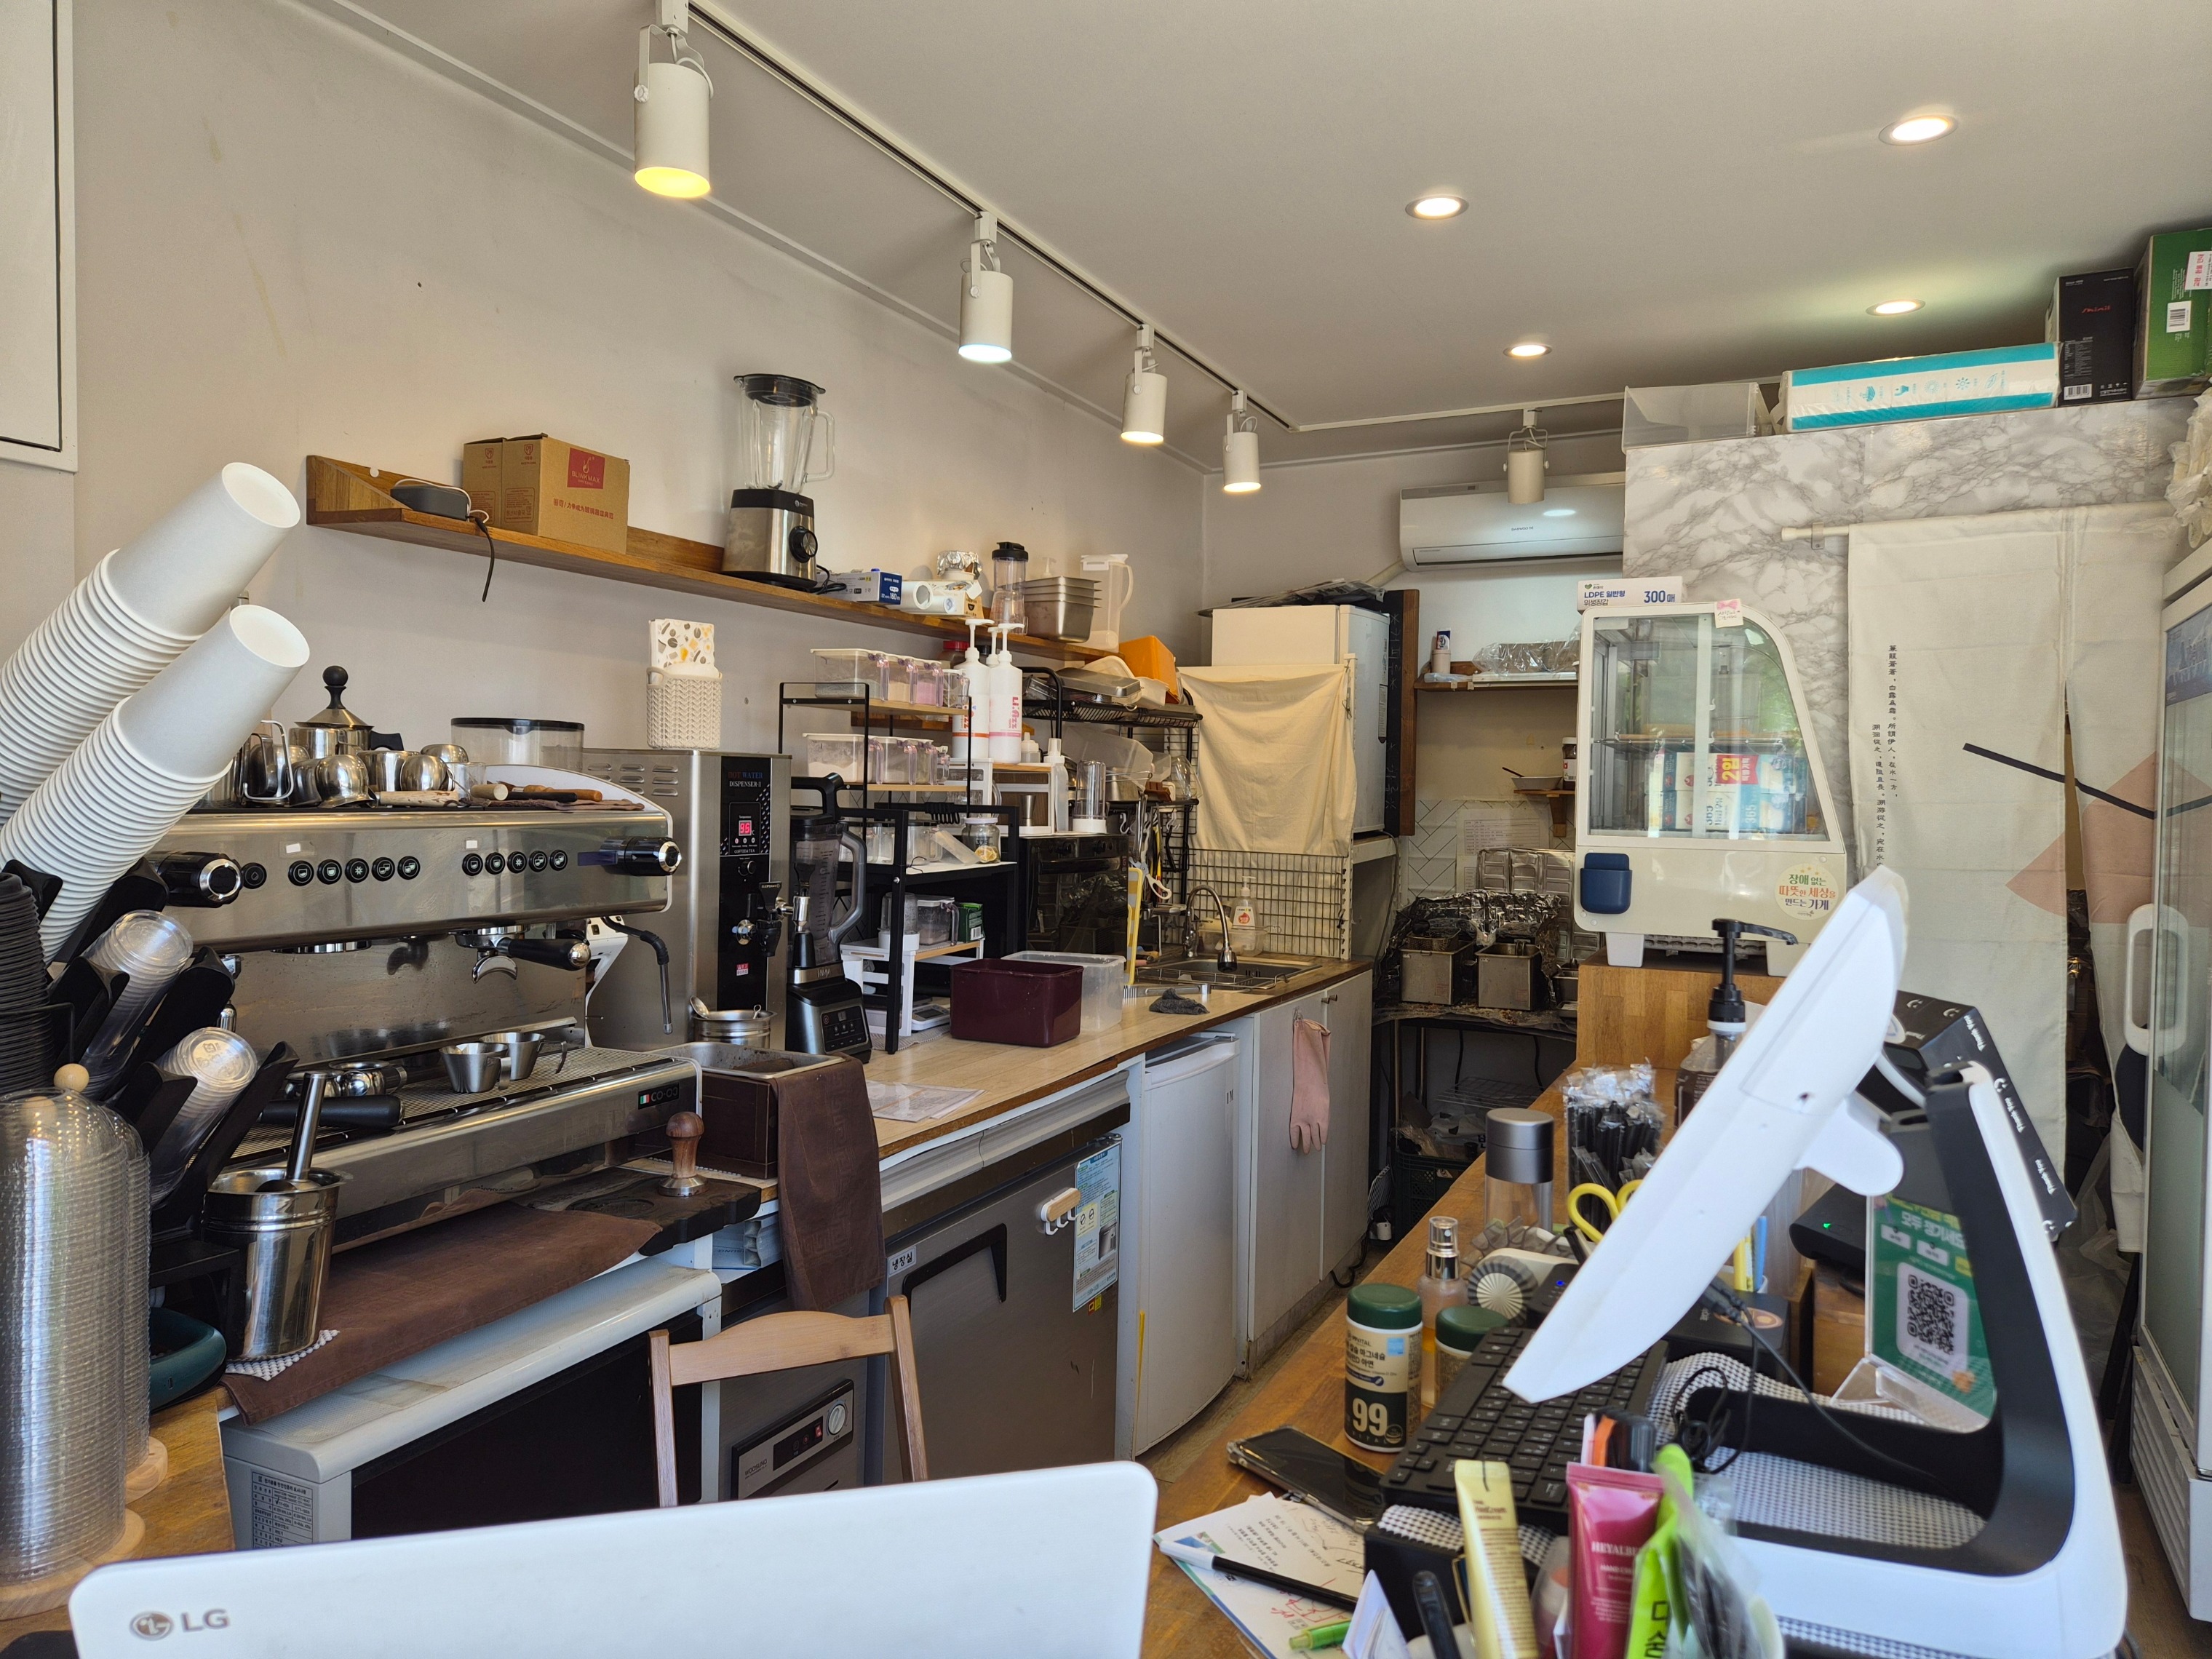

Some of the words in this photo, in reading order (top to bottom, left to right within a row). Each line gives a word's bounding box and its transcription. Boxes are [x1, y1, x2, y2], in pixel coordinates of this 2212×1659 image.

[571, 470, 600, 484] BLINKMAX
[1644, 590, 1666, 603] 300
[1667, 594, 1676, 602] 매
[742, 771, 763, 779] WATER
[1789, 874, 1809, 886] 장애
[1810, 877, 1826, 886] 없는
[1778, 886, 1806, 897] 따뜻한
[1808, 887, 1836, 899] 세상을
[1785, 898, 1807, 907] 만드는
[1808, 899, 1829, 910] 가게
[1964, 1014, 1975, 1030] You
[1971, 1027, 1986, 1051] Thank
[2005, 1097, 2016, 1112] You
[2010, 1110, 2025, 1133] Thank
[2035, 1159, 2045, 1174] You
[2040, 1171, 2057, 1195] Thank
[1901, 1211, 1922, 1230] 모두
[892, 1252, 912, 1270] 냉장실
[1359, 1348, 1385, 1361] 마그네슘
[1361, 1358, 1374, 1369] 아연
[1352, 1397, 1388, 1436] 99
[181, 1607, 230, 1633] LG
